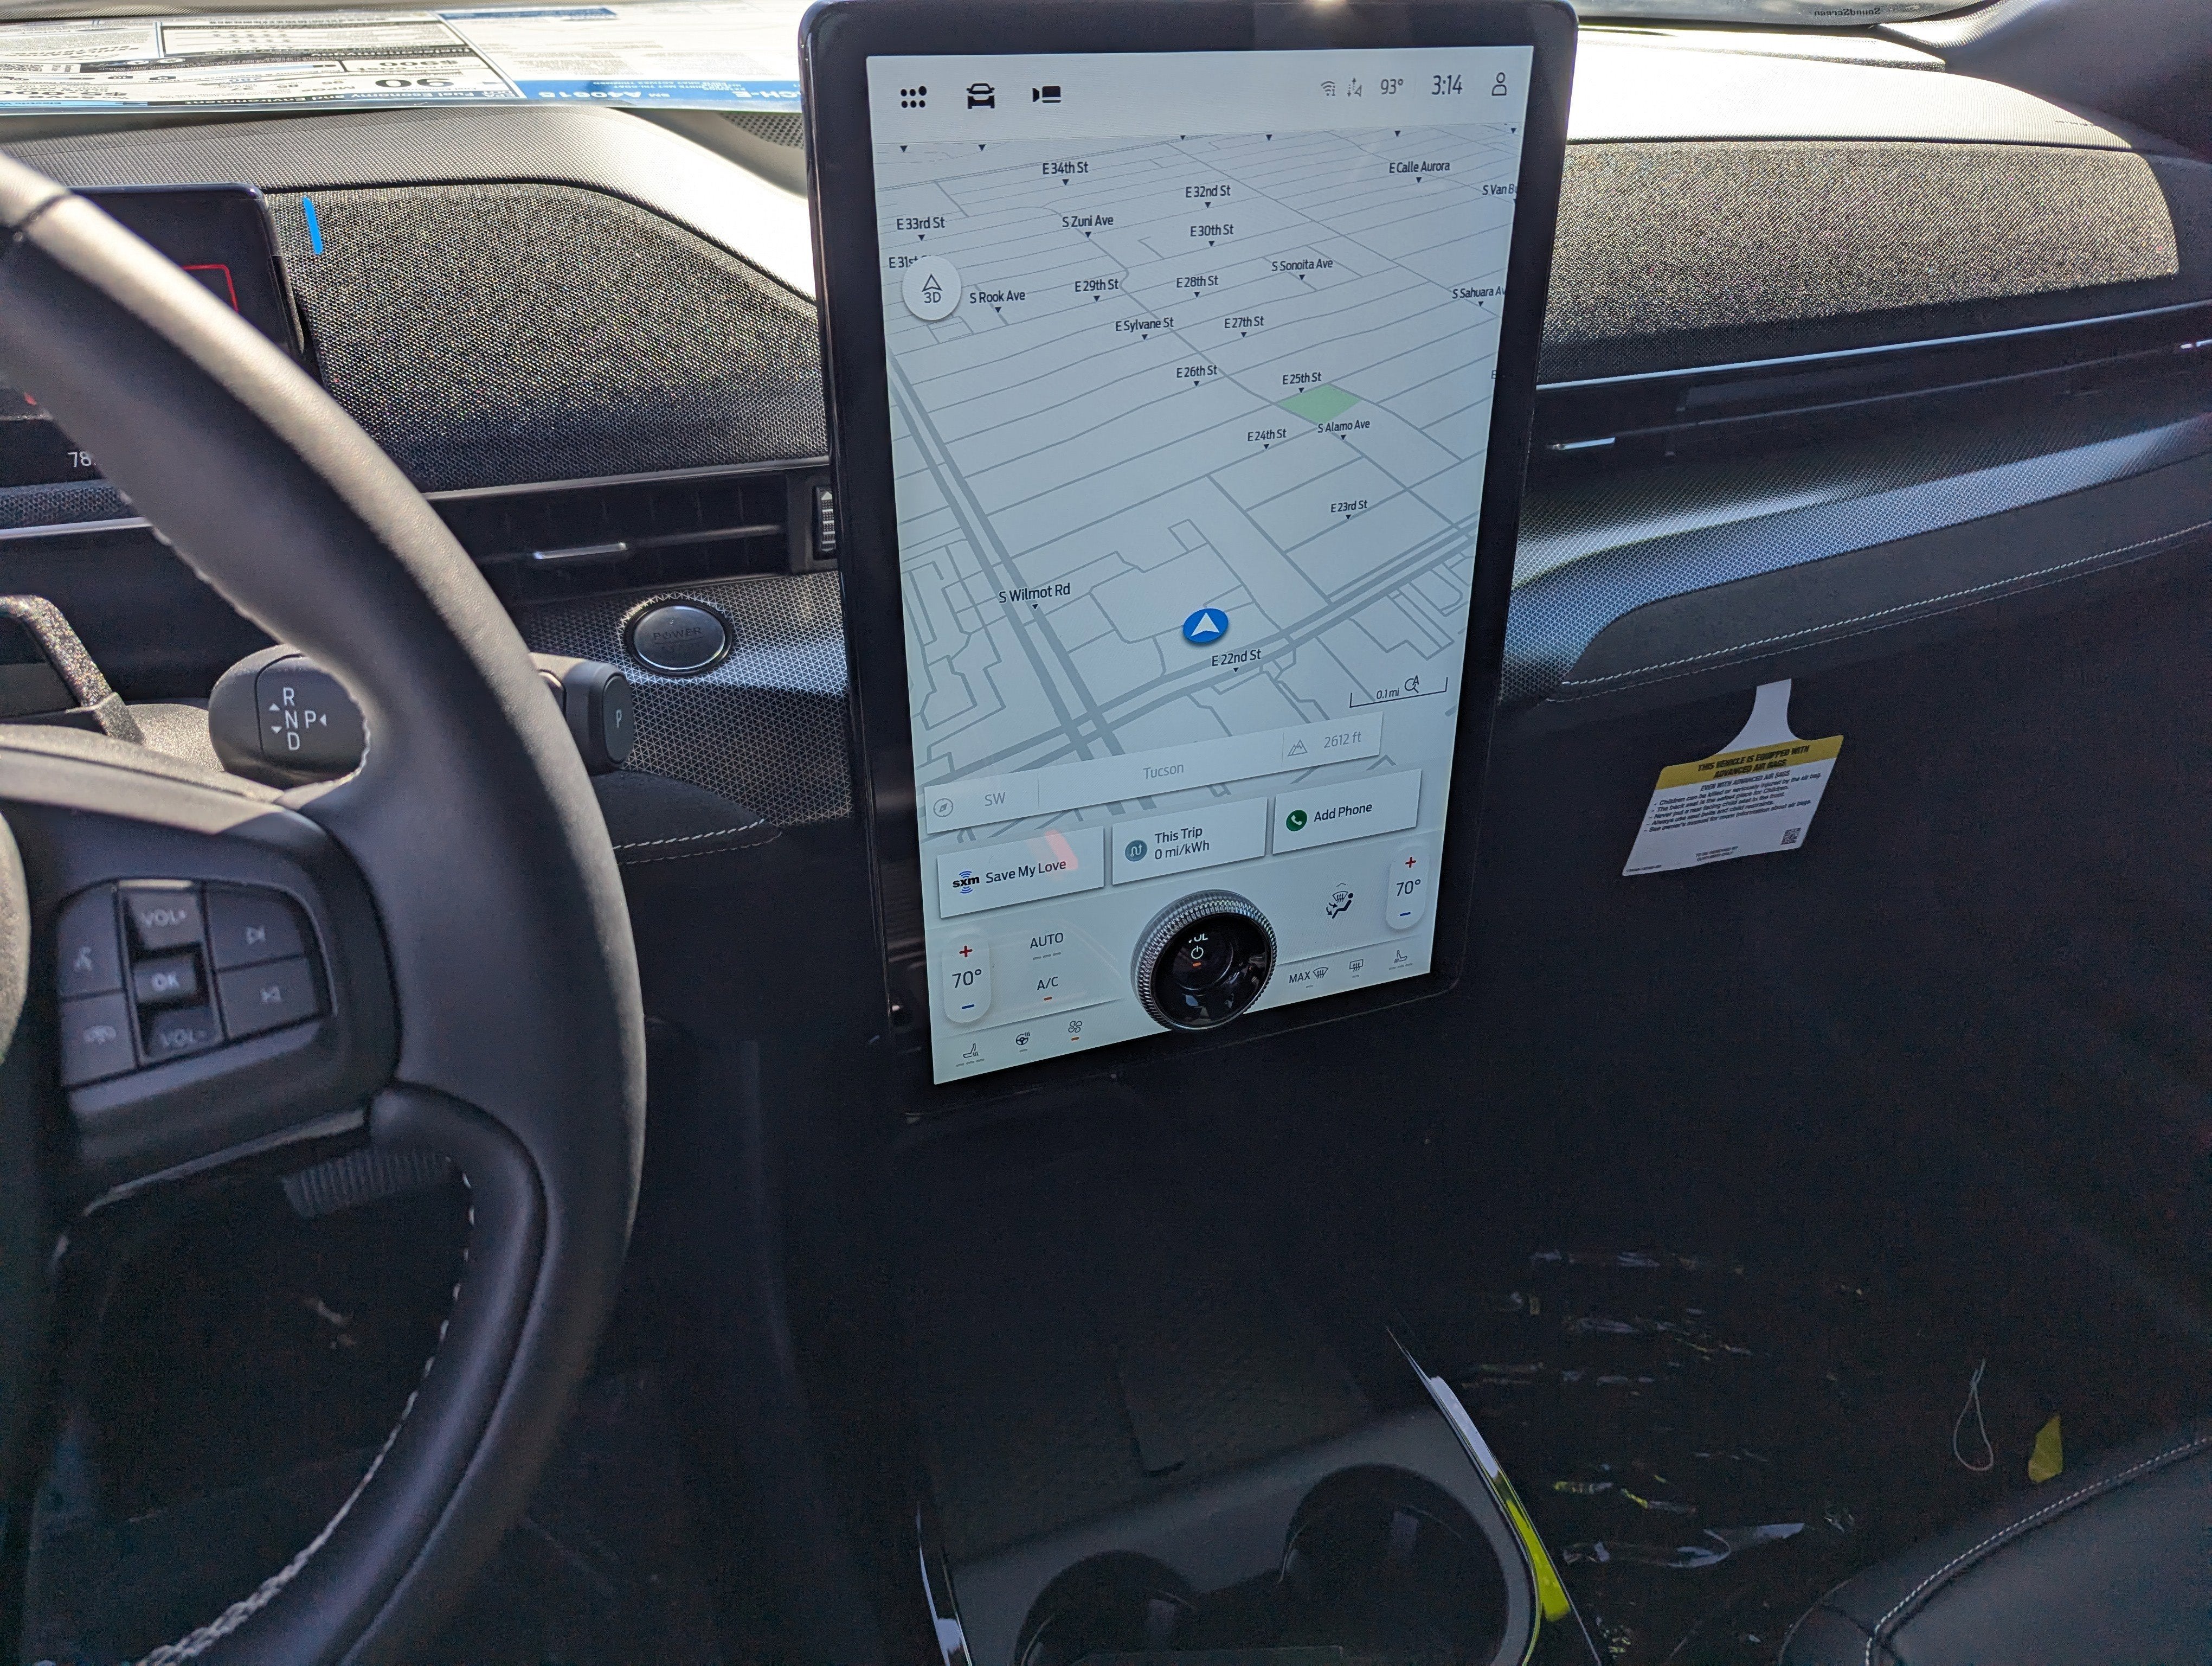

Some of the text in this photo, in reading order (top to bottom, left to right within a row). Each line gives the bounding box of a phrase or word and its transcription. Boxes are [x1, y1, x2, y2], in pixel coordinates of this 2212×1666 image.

[375, 78, 454, 88] 90
[1380, 78, 1404, 95] 93°
[1431, 74, 1462, 95] 3:14
[1042, 161, 1089, 175] E 34th St
[1389, 161, 1450, 174] E Calle Aurora
[1186, 184, 1231, 197] E 32nd St
[1482, 185, 1488, 196] S
[1490, 184, 1507, 195] Van
[897, 216, 946, 230] E 33rd St
[1062, 214, 1114, 228] S Zuni Ave
[1190, 223, 1234, 237] E 30th St
[889, 257, 896, 269] E
[1271, 258, 1334, 272] S Sonoita Ave
[1075, 279, 1119, 292] E 29th St
[1176, 275, 1219, 288] E 28th St
[924, 292, 941, 304] 3D
[969, 290, 1026, 304] S Rook Ave
[1452, 288, 1458, 299] S
[1459, 286, 1494, 298] Sahuara
[1115, 317, 1174, 333] E Sylvane St
[1224, 316, 1264, 329] E 27th St
[1176, 364, 1218, 378] E 26th St
[1282, 371, 1322, 385] E 25th St
[1317, 419, 1371, 434] S Alamo Ave
[1248, 428, 1287, 442] E 24th St
[1330, 499, 1368, 513] E 23rd St
[999, 582, 1071, 604] S Wilmot Rd
[1212, 649, 1262, 667] E 22nd St
[282, 687, 295, 706] R
[1376, 687, 1399, 700] 0.1 mi
[285, 709, 317, 729] N P
[615, 709, 623, 728] P
[287, 732, 301, 751] D
[1323, 731, 1362, 749] 2612 ft
[1143, 762, 1185, 780] Tucson
[984, 791, 1006, 807] SW
[1313, 803, 1373, 823] Add Phone
[1154, 826, 1203, 845] This Trip
[1154, 840, 1210, 861] 0 mi/kWh
[986, 859, 1067, 884] Save My Love
[952, 875, 981, 889] sxm
[1396, 879, 1421, 897] 70°
[1030, 932, 1064, 950] AUTO
[152, 972, 181, 992] OK
[951, 968, 982, 989] 70°
[1037, 976, 1059, 991] A/C
[1289, 970, 1311, 984] MAX
